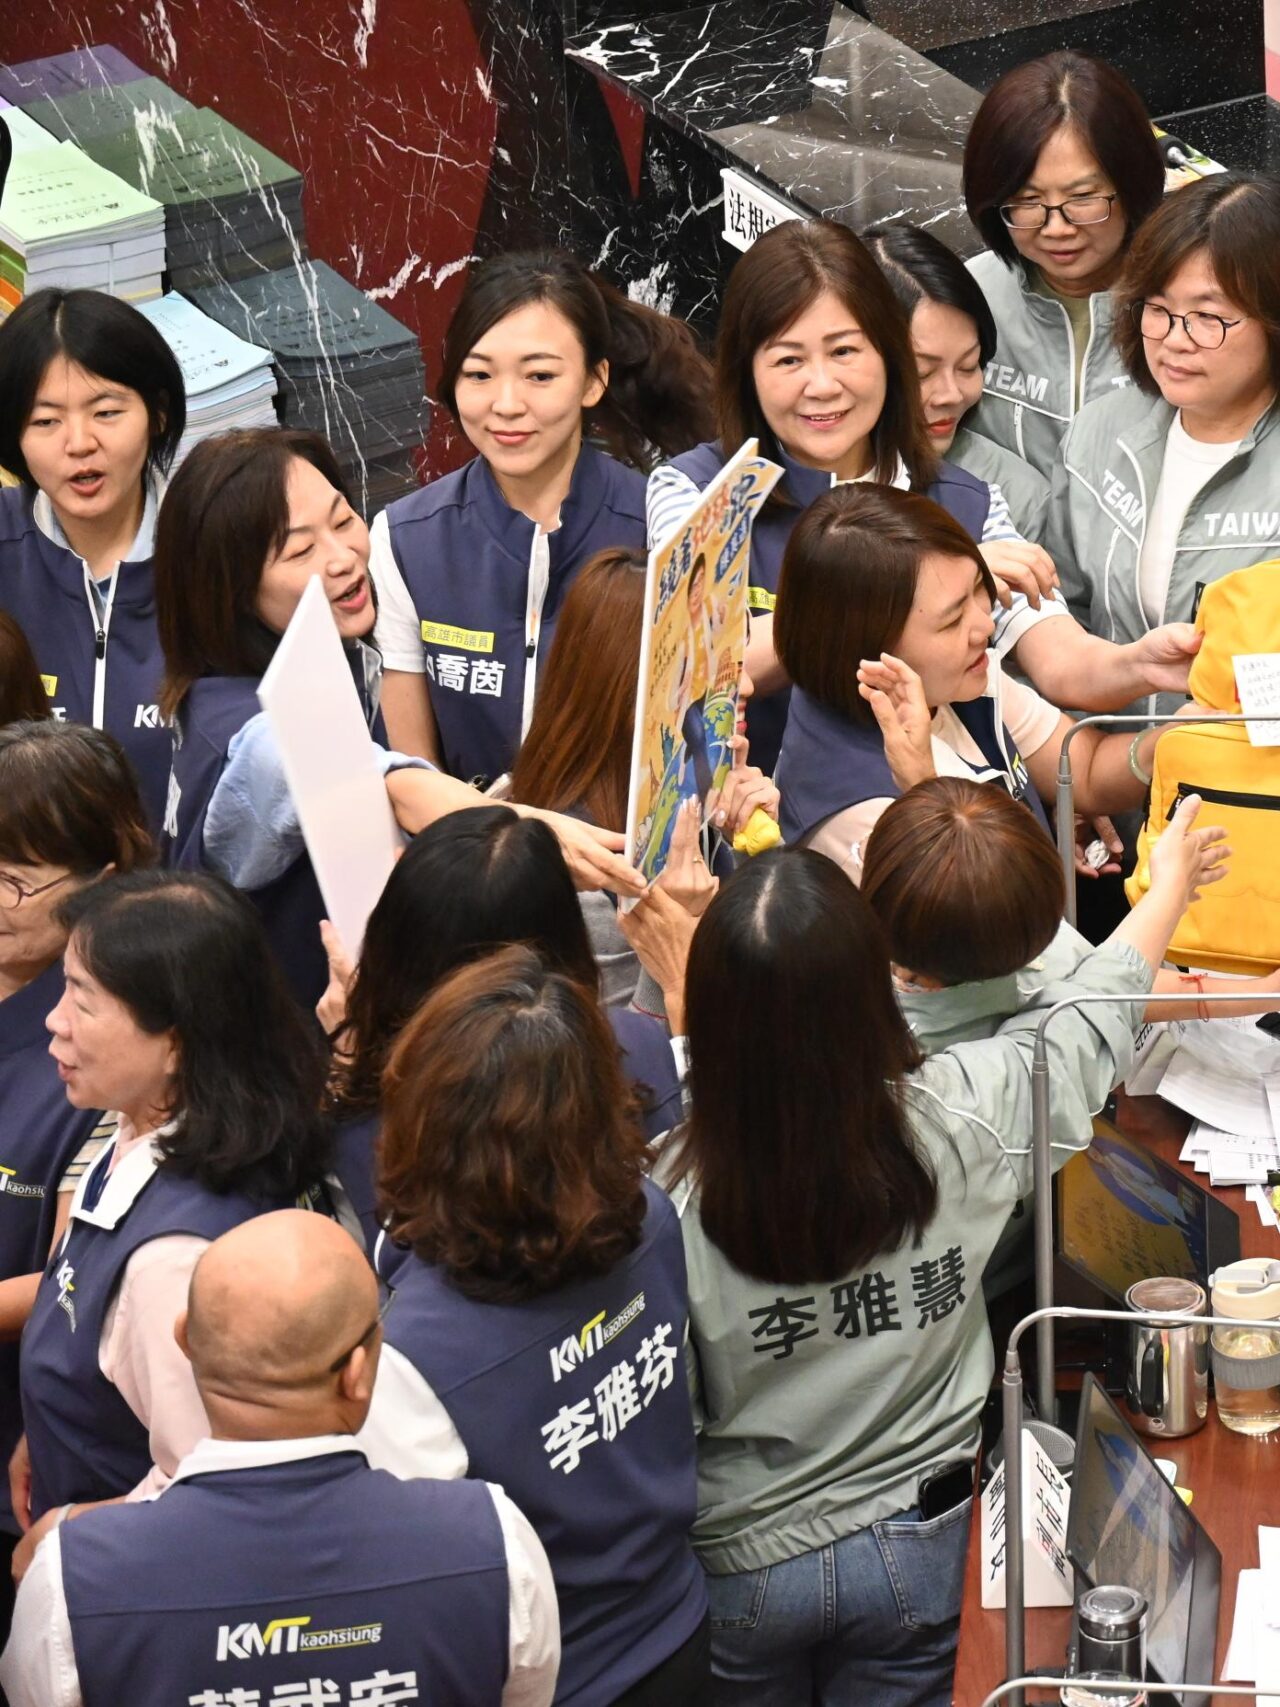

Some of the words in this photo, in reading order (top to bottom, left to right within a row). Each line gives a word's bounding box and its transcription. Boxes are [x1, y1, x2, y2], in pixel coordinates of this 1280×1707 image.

[984, 362, 1049, 401] TEAM
[1101, 470, 1145, 528] TEAM
[424, 625, 488, 648] 高雄市議員
[748, 1245, 966, 1360] 李雅慧
[549, 1310, 606, 1383] KMT
[603, 1294, 646, 1340] kaohsiung
[541, 1322, 677, 1475] 李雅芬
[216, 1616, 311, 1661] KMT
[301, 1625, 382, 1648] kaohsiung
